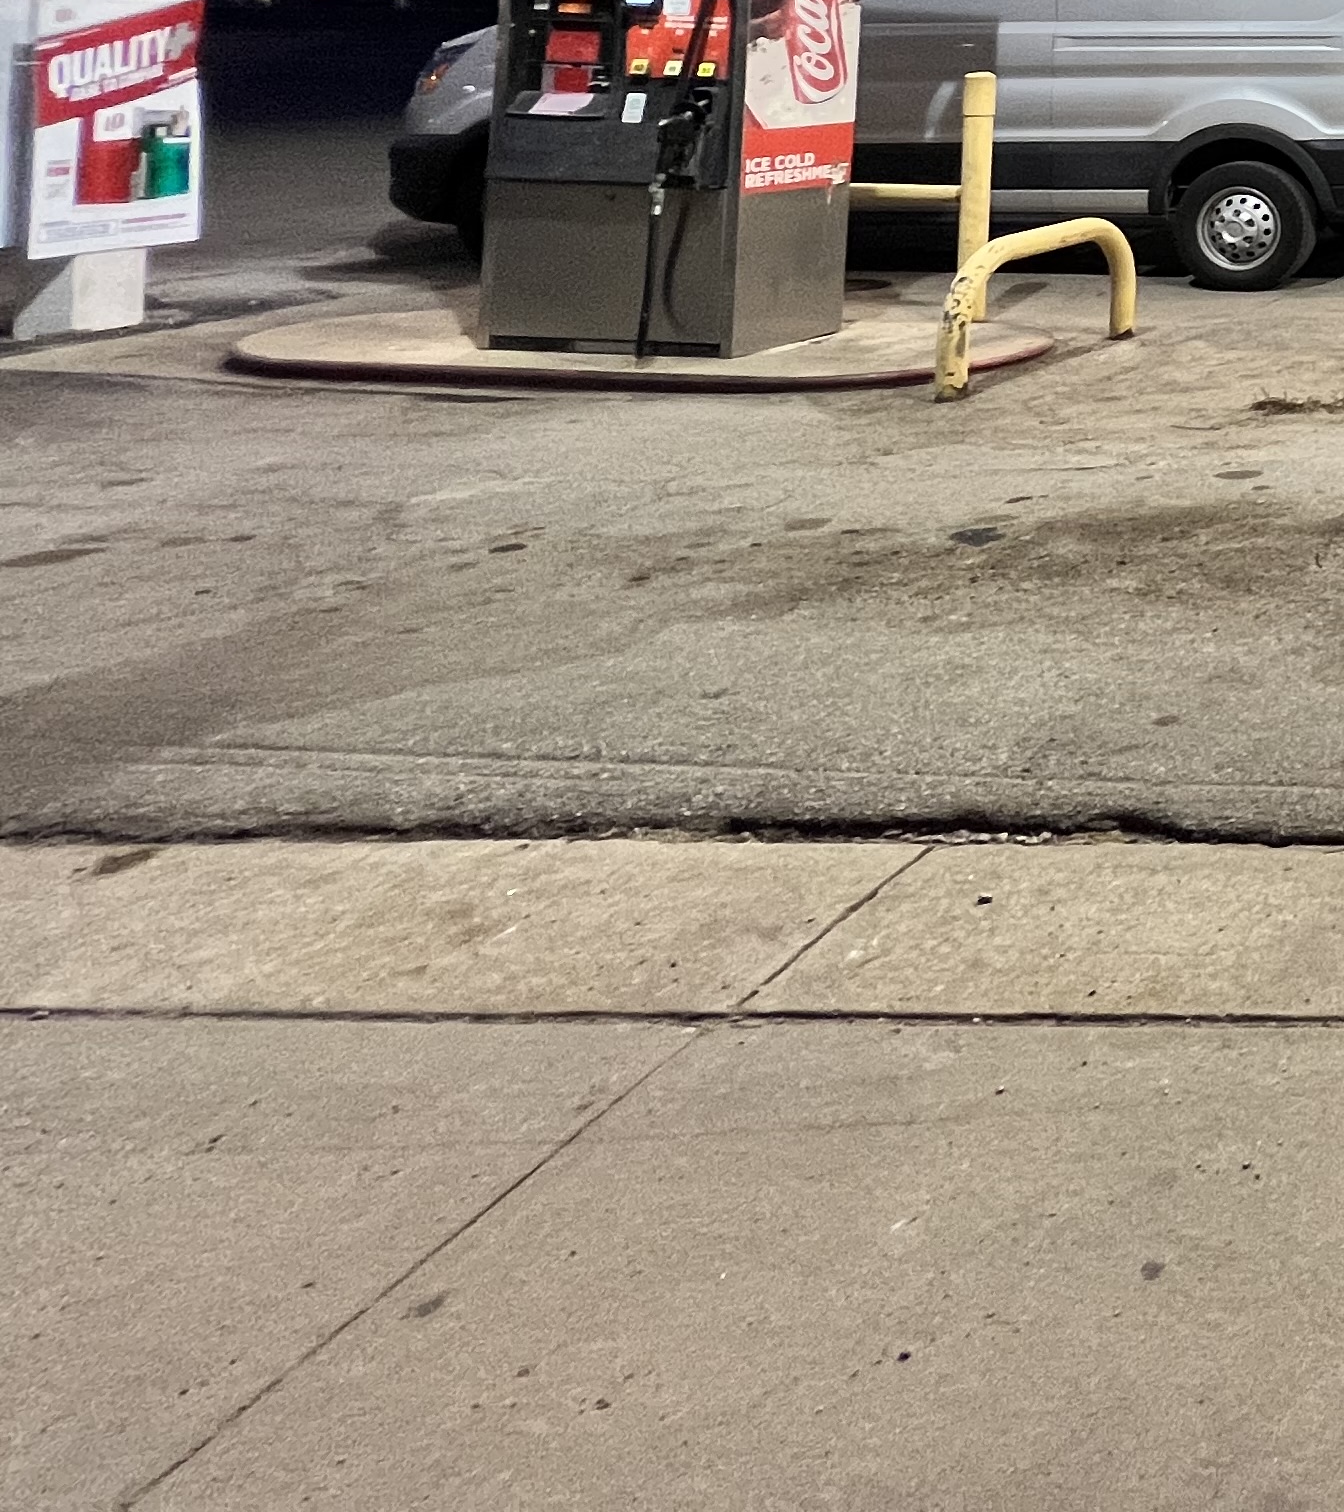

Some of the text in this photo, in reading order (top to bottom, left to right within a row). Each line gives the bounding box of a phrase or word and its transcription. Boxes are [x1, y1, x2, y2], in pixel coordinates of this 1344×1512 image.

[745, 152, 815, 173] ICE COLD
[744, 163, 850, 189] REFRESHME
